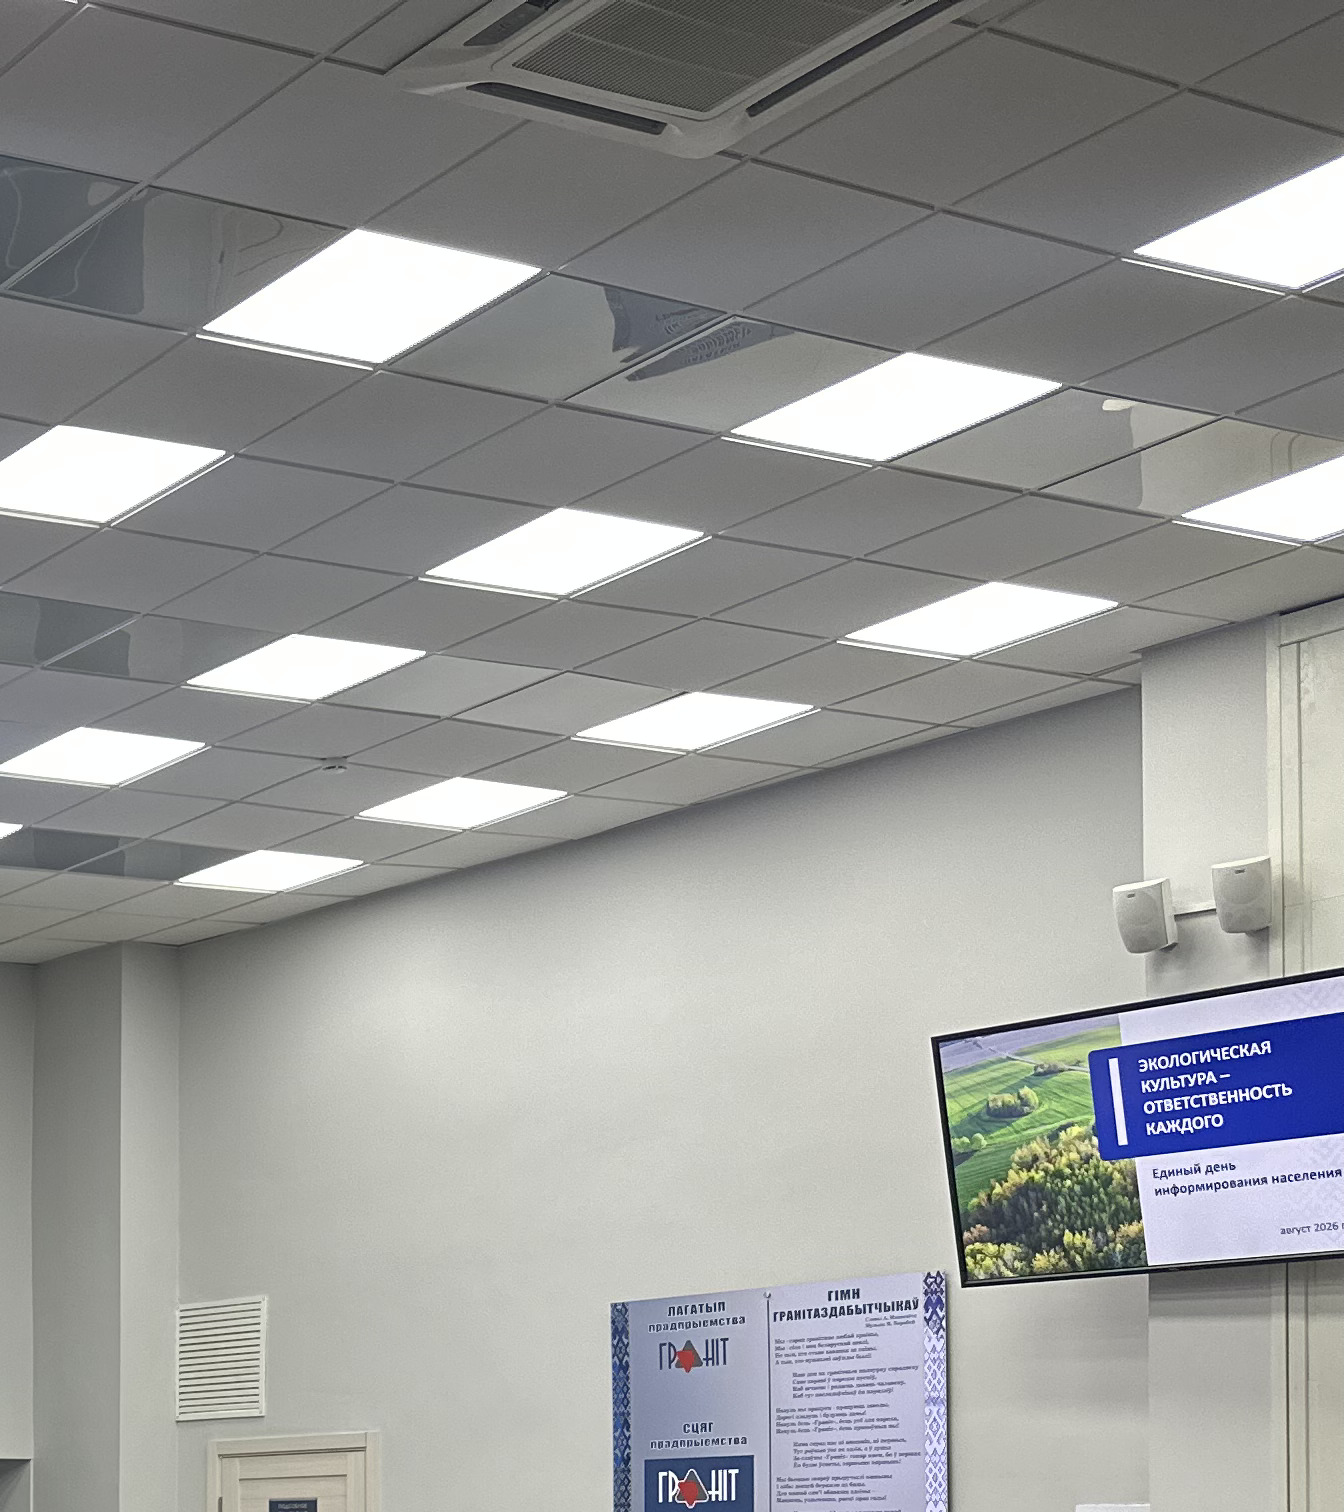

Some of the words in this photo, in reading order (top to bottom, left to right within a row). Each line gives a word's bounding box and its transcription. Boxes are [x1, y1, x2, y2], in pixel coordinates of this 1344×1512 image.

[1138, 1040, 1272, 1073] ЭКОЛОГИЧЕСКАЯ
[1140, 1070, 1218, 1093] КУЛЬТУРА
[1143, 1083, 1293, 1115] ОТВЕТСТВЕННОСТЬ
[1145, 1113, 1224, 1136] КАЖДОГО
[1152, 1162, 1201, 1181] Единый
[1205, 1162, 1237, 1176] день
[1154, 1176, 1268, 1197] информирования
[1271, 1167, 1343, 1185] населения
[1314, 1221, 1340, 1233] 2026
[827, 1288, 860, 1302] ГІМН
[667, 1301, 726, 1317] ЛАГАТЫП
[682, 1422, 714, 1435] СЦЯГ
